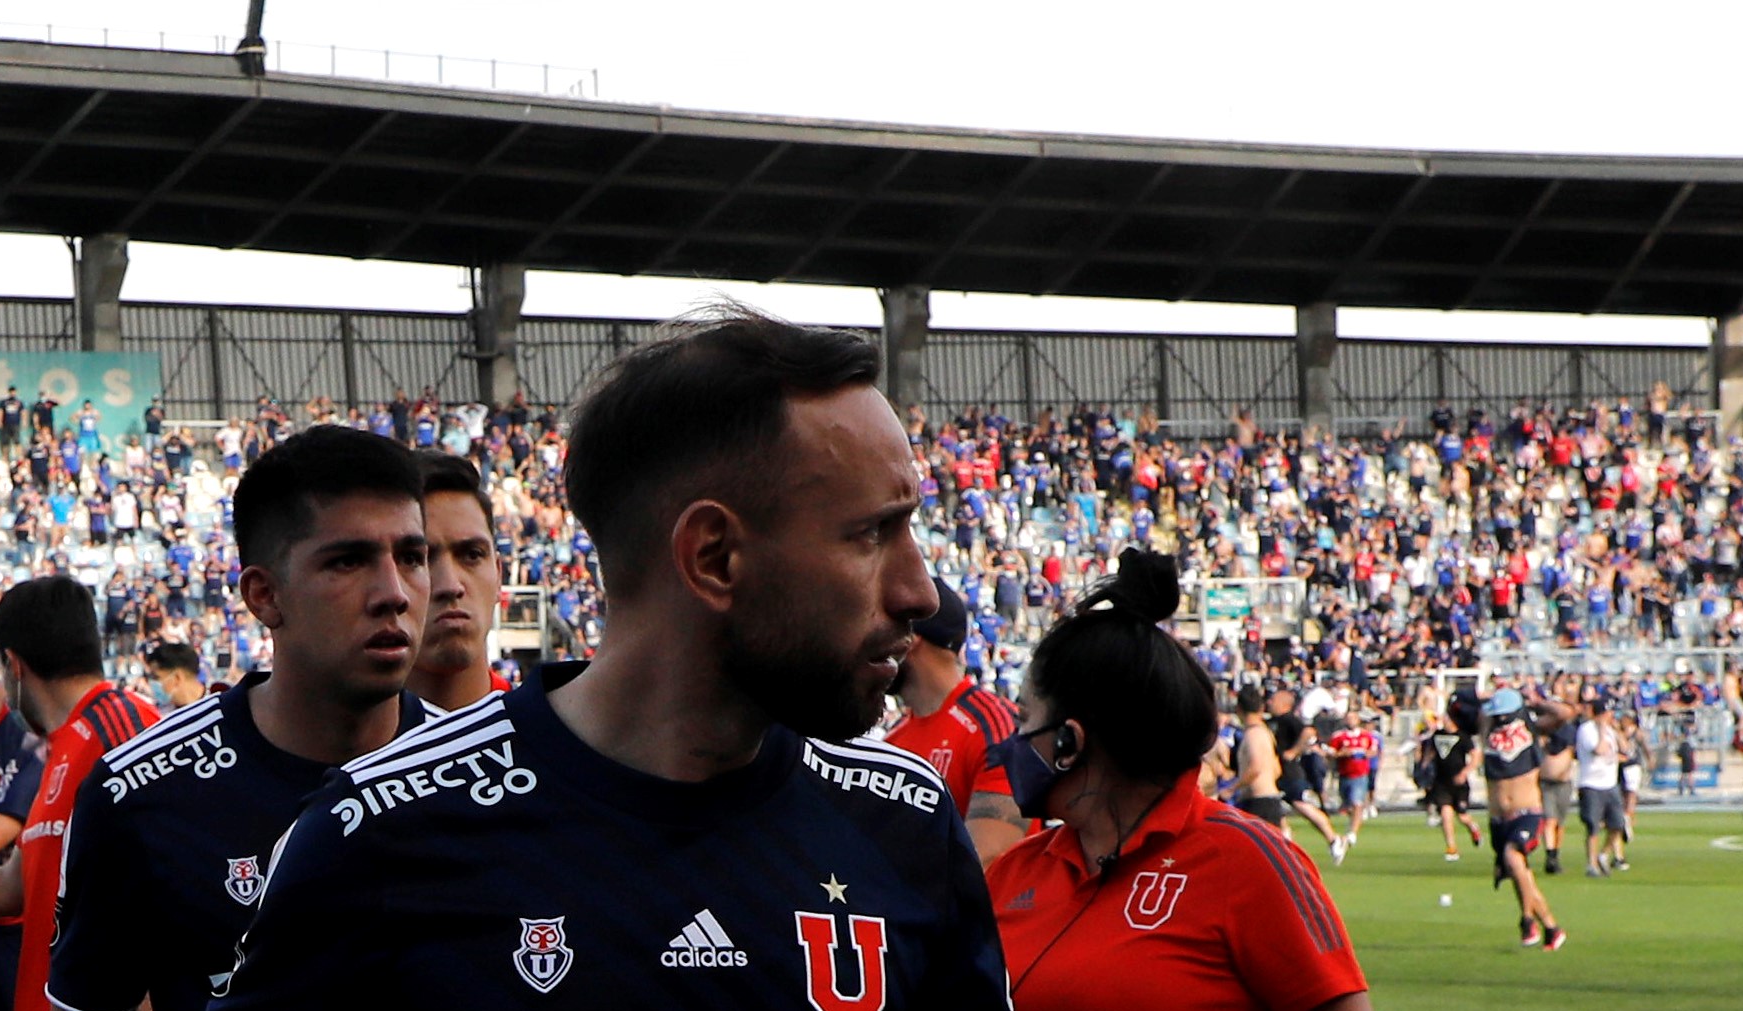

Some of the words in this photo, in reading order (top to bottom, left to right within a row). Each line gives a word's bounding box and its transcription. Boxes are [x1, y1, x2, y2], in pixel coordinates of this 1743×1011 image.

[101, 724, 223, 803] DIRECTV
[194, 747, 238, 779] GO
[469, 767, 538, 806] GO
[330, 739, 515, 838] DIRECTV
[1124, 872, 1188, 930] U
[660, 944, 749, 968] adidas
